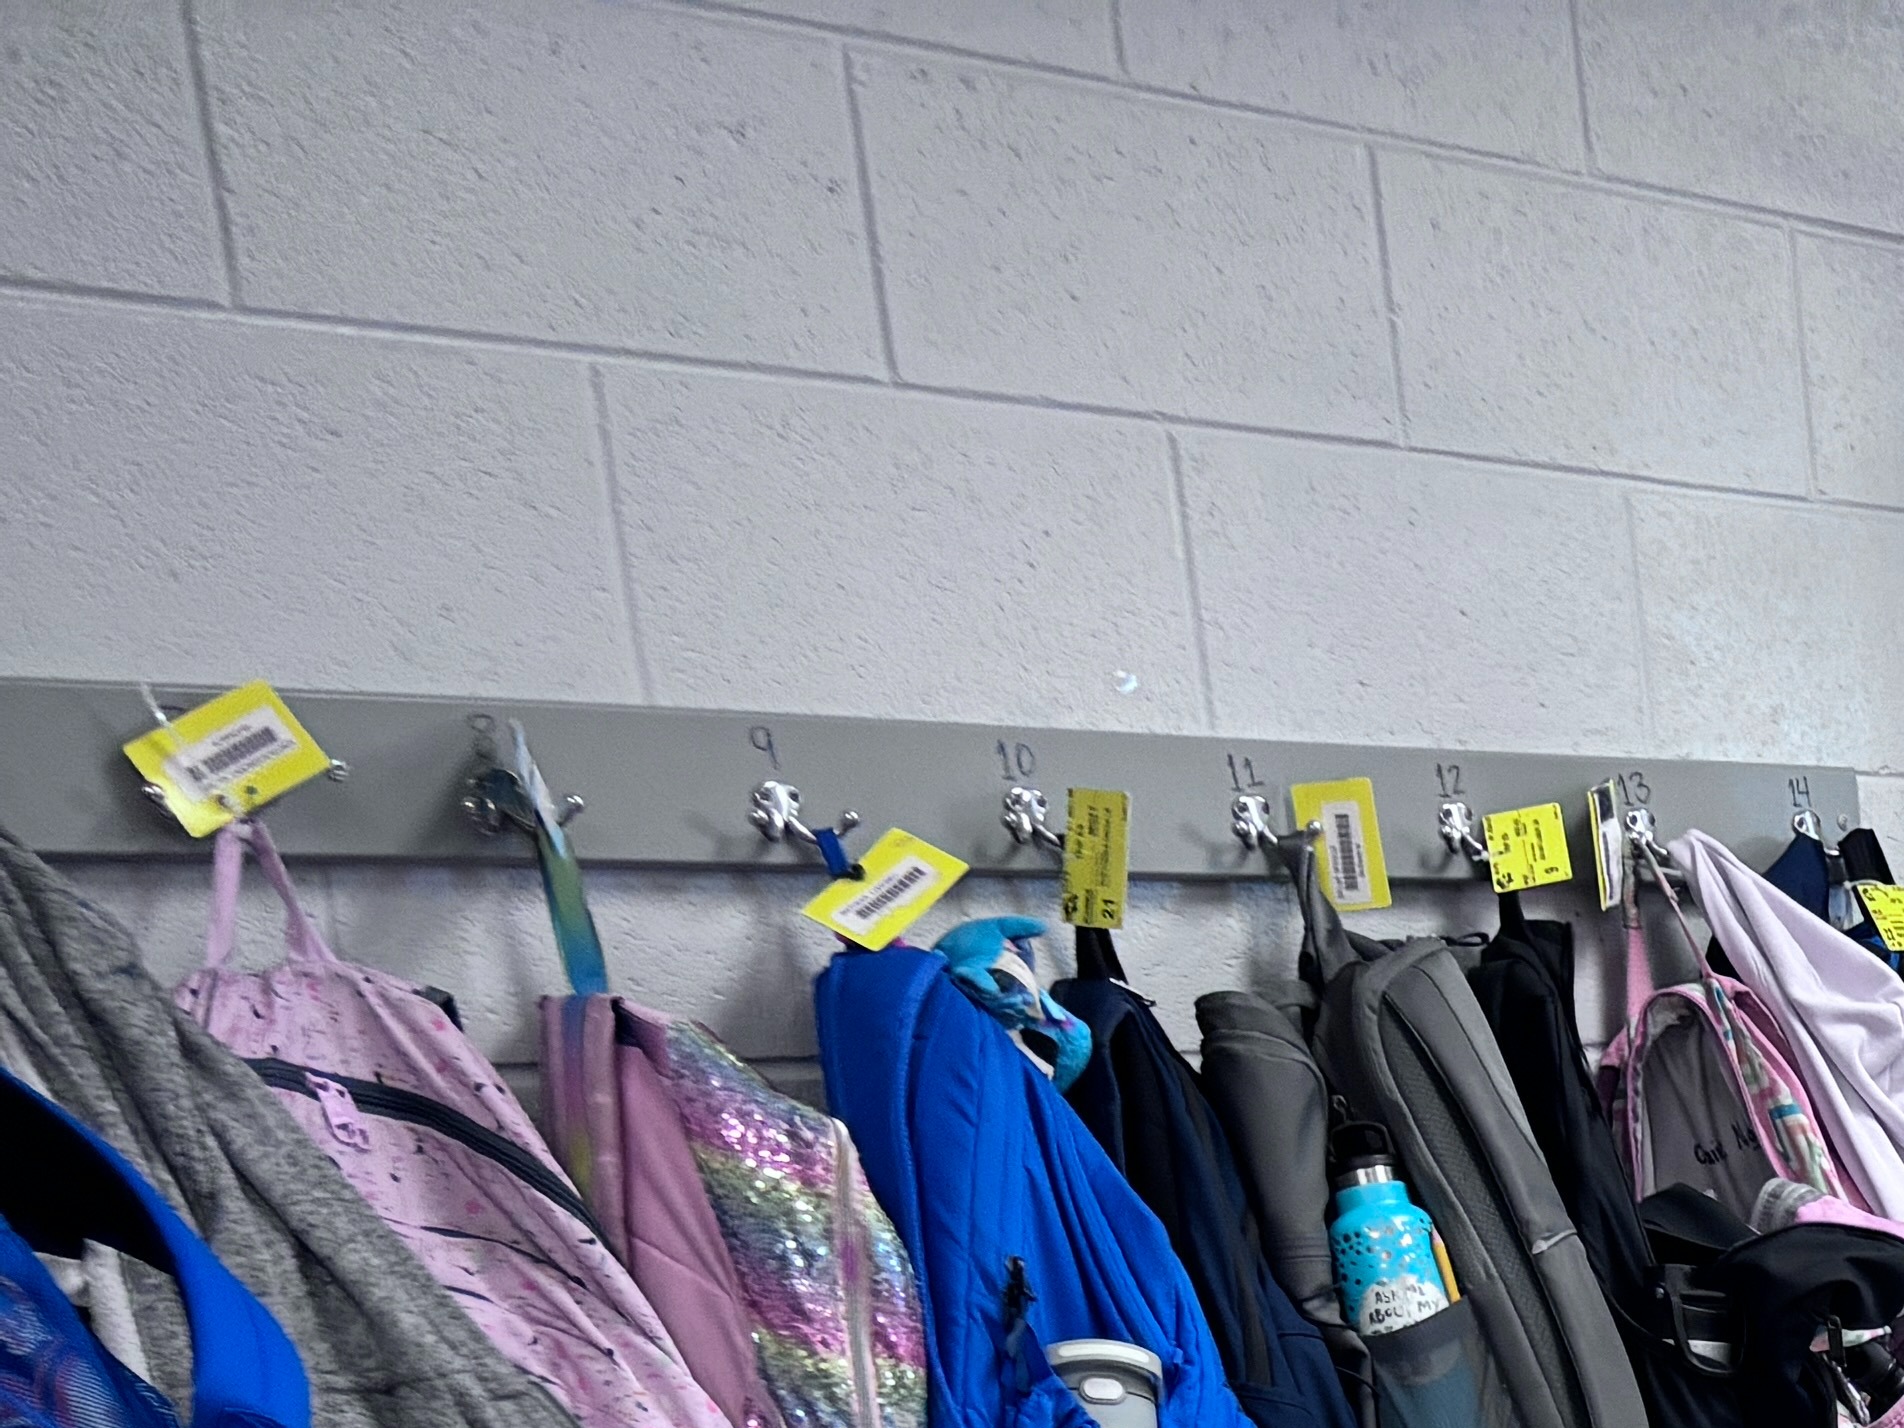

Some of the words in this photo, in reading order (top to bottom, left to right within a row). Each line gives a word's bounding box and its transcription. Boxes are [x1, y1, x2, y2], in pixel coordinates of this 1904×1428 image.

[995, 739, 1036, 781] 10
[1226, 753, 1265, 792] 11
[1435, 762, 1466, 798] 12
[1617, 771, 1652, 806] 13
[1788, 775, 1812, 808] 14
